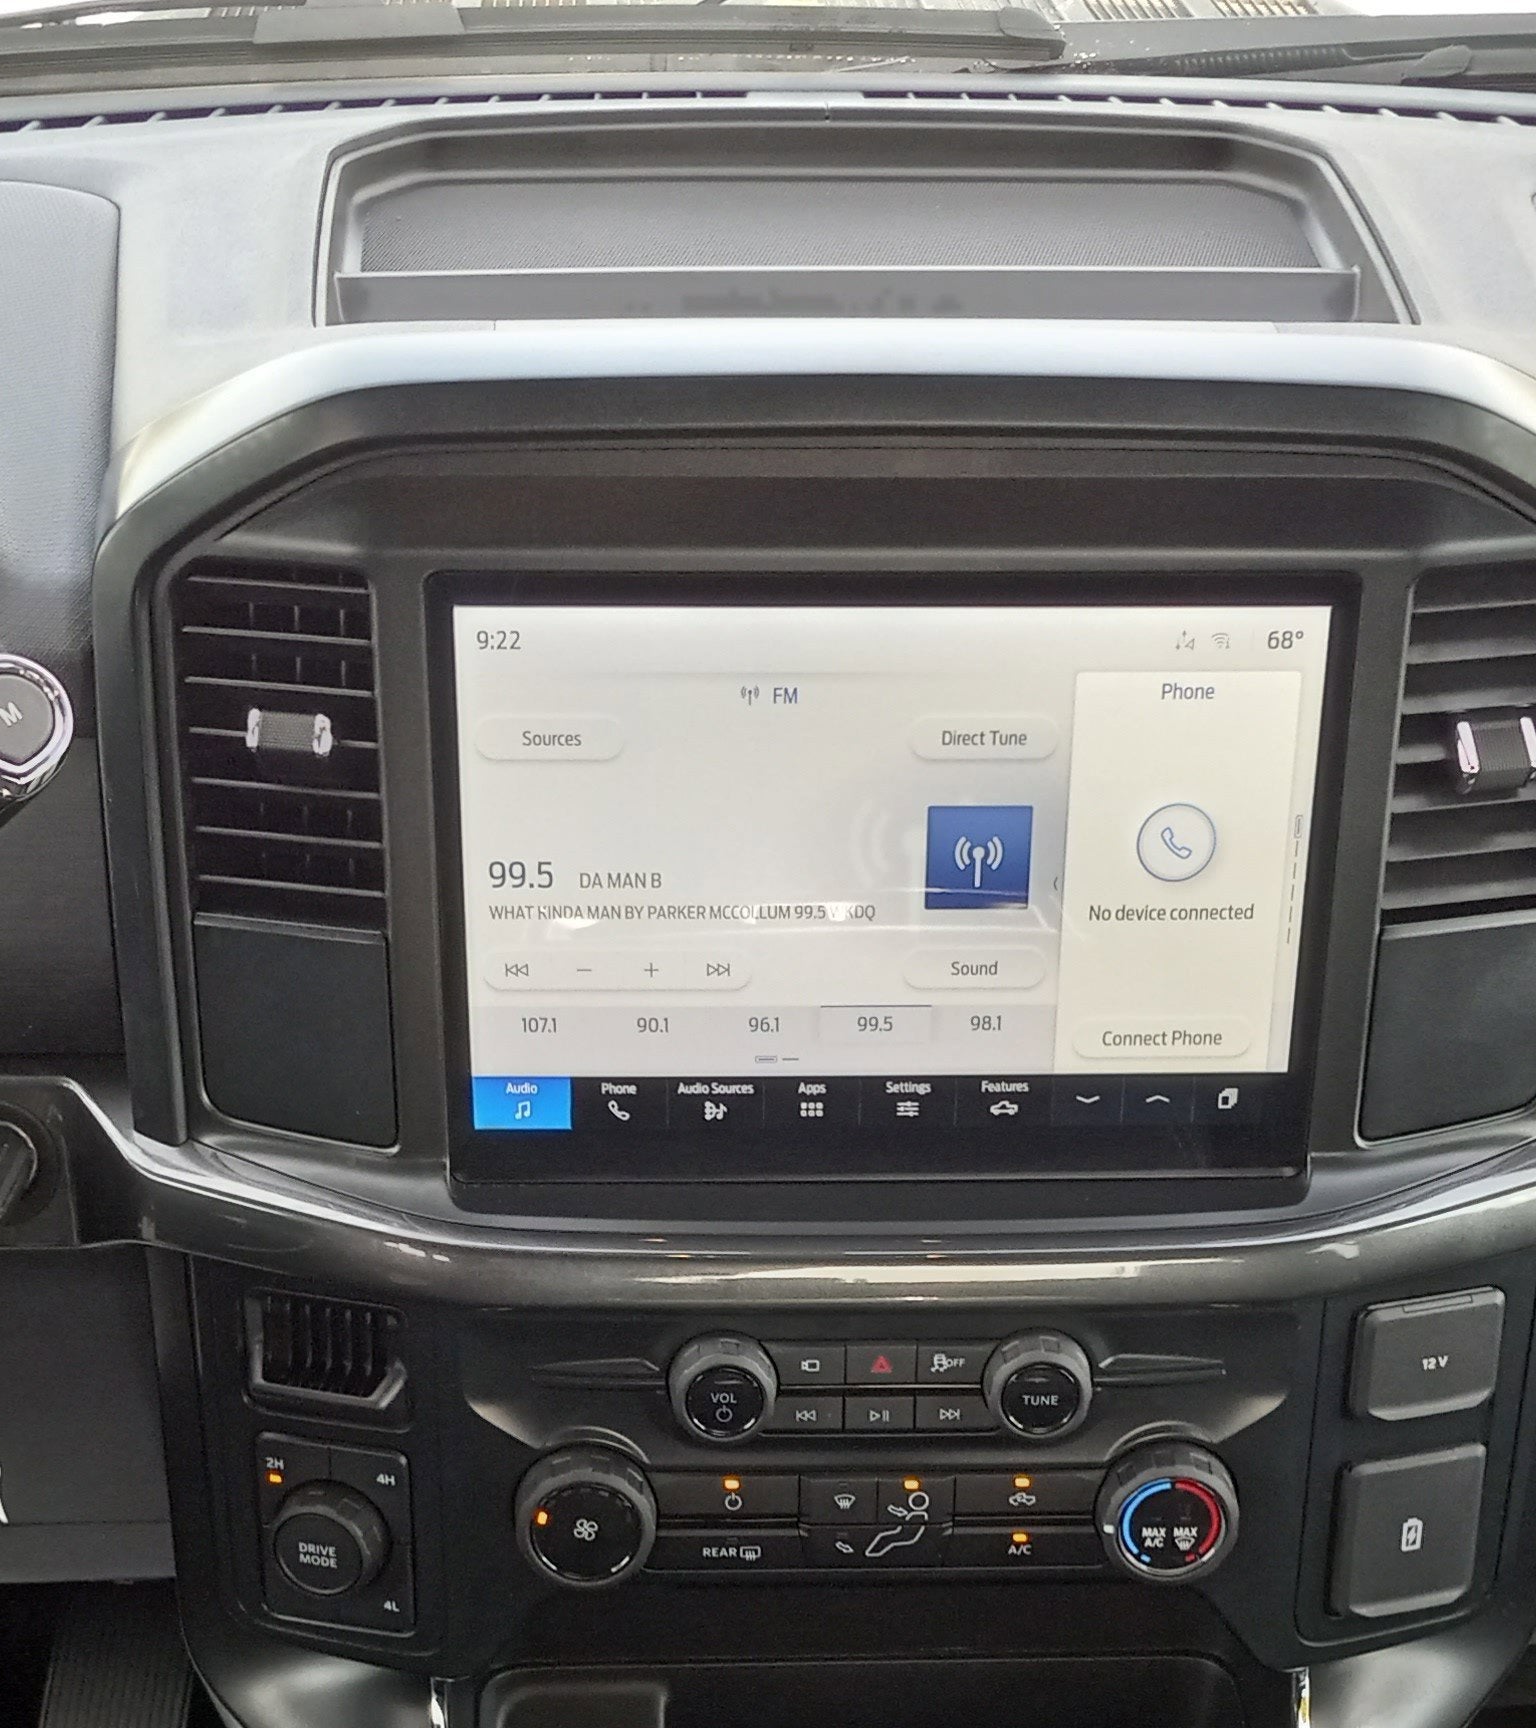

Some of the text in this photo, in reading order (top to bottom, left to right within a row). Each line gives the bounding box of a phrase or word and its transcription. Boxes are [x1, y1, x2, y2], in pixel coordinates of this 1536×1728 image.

[476, 630, 522, 651] 9:22
[1267, 630, 1305, 650] 68°
[772, 687, 799, 705] FM
[1161, 683, 1215, 701] Phone
[522, 730, 582, 747] Sources
[941, 730, 1028, 747] Direct Tune
[488, 861, 554, 889] 99.5
[579, 873, 662, 889] DA MAN B
[489, 905, 534, 920] WHAT
[537, 905, 584, 920] KINDA
[587, 905, 621, 920] MAN
[624, 905, 644, 920] BY
[647, 904, 706, 920] PARKER
[710, 904, 790, 920] MCCOLLUM
[794, 904, 826, 920] 99.5
[1089, 904, 1254, 922] No device connected
[951, 960, 998, 976] Sound
[521, 1017, 557, 1033] 107.1
[637, 1017, 669, 1033] 90.1
[749, 1017, 780, 1033] 96.1
[857, 1016, 893, 1033] 99.5
[970, 1015, 1002, 1032] 98.1
[1102, 1030, 1222, 1047] Connect Phone
[505, 1081, 538, 1096] Audio
[601, 1081, 637, 1096] Phone
[678, 1081, 754, 1096] Audio Sources
[798, 1082, 827, 1098] Apps
[885, 1080, 931, 1098] Settings
[981, 1080, 1029, 1094] Features
[946, 1358, 966, 1368] OFF
[710, 1392, 737, 1404] VOL
[1022, 1395, 1059, 1406] TUNE
[265, 1457, 284, 1471] 2H
[376, 1473, 395, 1486] 4H
[1141, 1527, 1166, 1538] MAX
[1173, 1527, 1198, 1538] MAX
[298, 1541, 337, 1558] DRIVE
[1008, 1544, 1032, 1556] A/C
[1144, 1538, 1164, 1549] A/C
[702, 1547, 737, 1558] REAR
[299, 1553, 338, 1569] MODE
[383, 1600, 400, 1613] 4L
